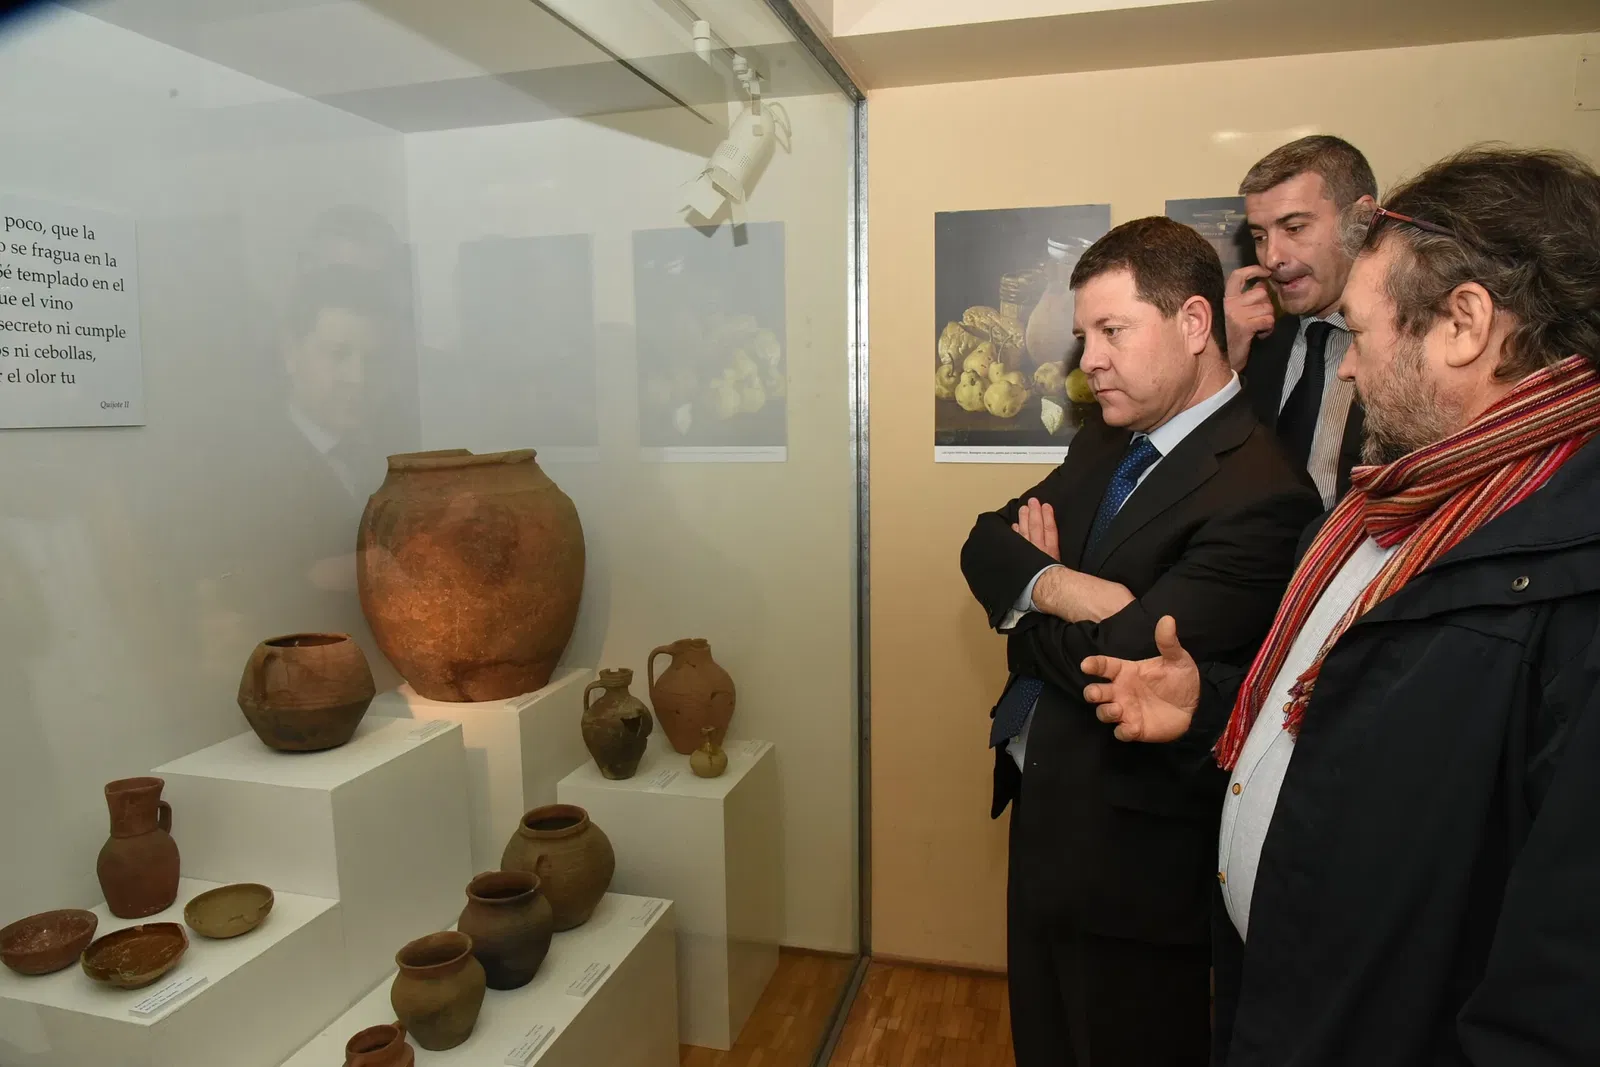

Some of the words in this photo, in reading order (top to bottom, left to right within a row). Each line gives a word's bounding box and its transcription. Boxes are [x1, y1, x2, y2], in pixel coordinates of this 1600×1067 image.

[4, 215, 47, 235] poco,
[51, 224, 79, 240] que
[83, 225, 95, 240] la
[11, 243, 27, 255] se
[32, 242, 80, 265] fragua
[84, 253, 101, 265] en
[105, 252, 117, 267] la
[17, 267, 89, 289] templado
[92, 278, 109, 290] en
[112, 278, 125, 292] el
[21, 292, 35, 308] el
[40, 295, 73, 311] vino
[0, 320, 52, 334] secreto
[56, 321, 71, 335] ni
[75, 324, 126, 342] cumple
[14, 343, 30, 358] ni
[34, 344, 96, 362] cebollas,
[7, 368, 21, 383] el
[25, 368, 56, 384] olor
[60, 371, 76, 384] tu
[100, 400, 123, 410] Quijote
